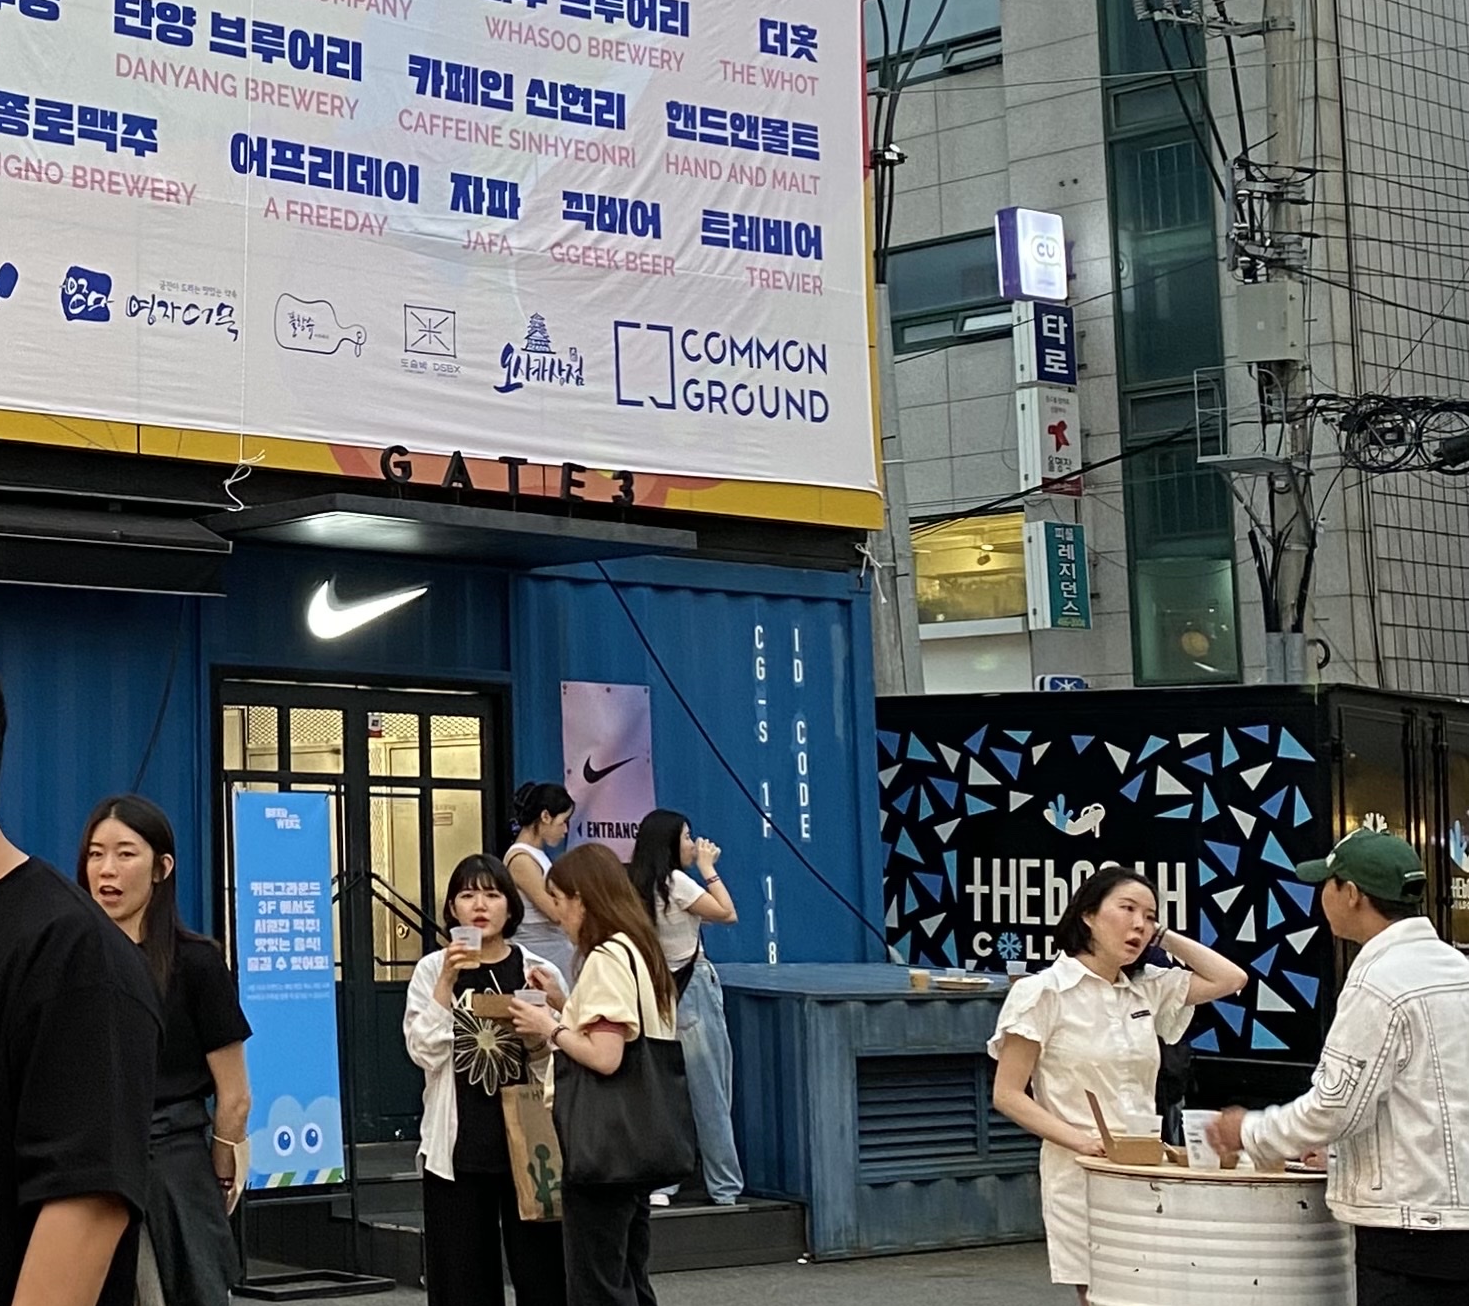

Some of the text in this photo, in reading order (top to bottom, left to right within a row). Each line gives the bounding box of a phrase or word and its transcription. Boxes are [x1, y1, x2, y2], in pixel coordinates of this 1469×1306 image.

[208, 10, 363, 83] 브루어리
[484, 15, 685, 74] WHASOO BREWERY
[115, 52, 360, 121] DANYANG BREWERY
[407, 53, 627, 131] 카페인 신현리
[719, 59, 819, 97] THE WHOT
[398, 108, 637, 169] CAFFEINE SINHYEONRI
[665, 99, 821, 162] 핸드앤몰트
[71, 164, 198, 207] BREWERY
[230, 132, 420, 205] 어프리데이
[665, 152, 821, 197] HAND AND MALT
[263, 196, 389, 238] A FREEDAY
[449, 171, 522, 221] 자파
[562, 189, 663, 241] 끽비어
[460, 228, 514, 257] JAFA
[549, 241, 677, 278] GGEEK BEER
[700, 208, 824, 262] 트레비어
[1036, 242, 1055, 259] CU
[745, 265, 825, 296] TREVIER
[681, 327, 829, 376] COMMON
[1042, 312, 1069, 376] 타로
[681, 375, 830, 424] GROUND
[586, 820, 642, 840] ENTRANC
[257, 899, 277, 915] 3F
